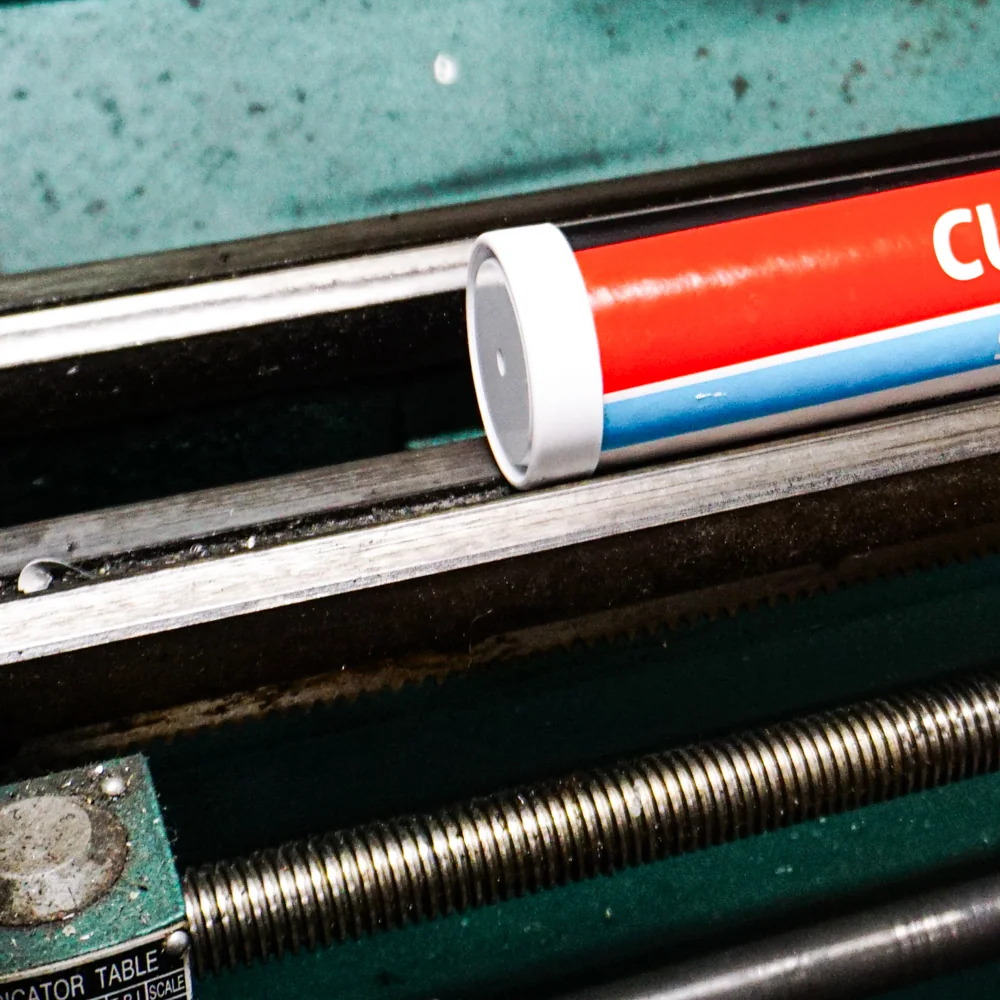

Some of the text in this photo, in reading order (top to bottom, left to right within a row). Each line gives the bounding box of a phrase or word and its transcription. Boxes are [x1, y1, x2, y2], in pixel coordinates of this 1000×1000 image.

[0, 950, 159, 1000] CATOR TABLE
[149, 974, 185, 1000] SCALE
